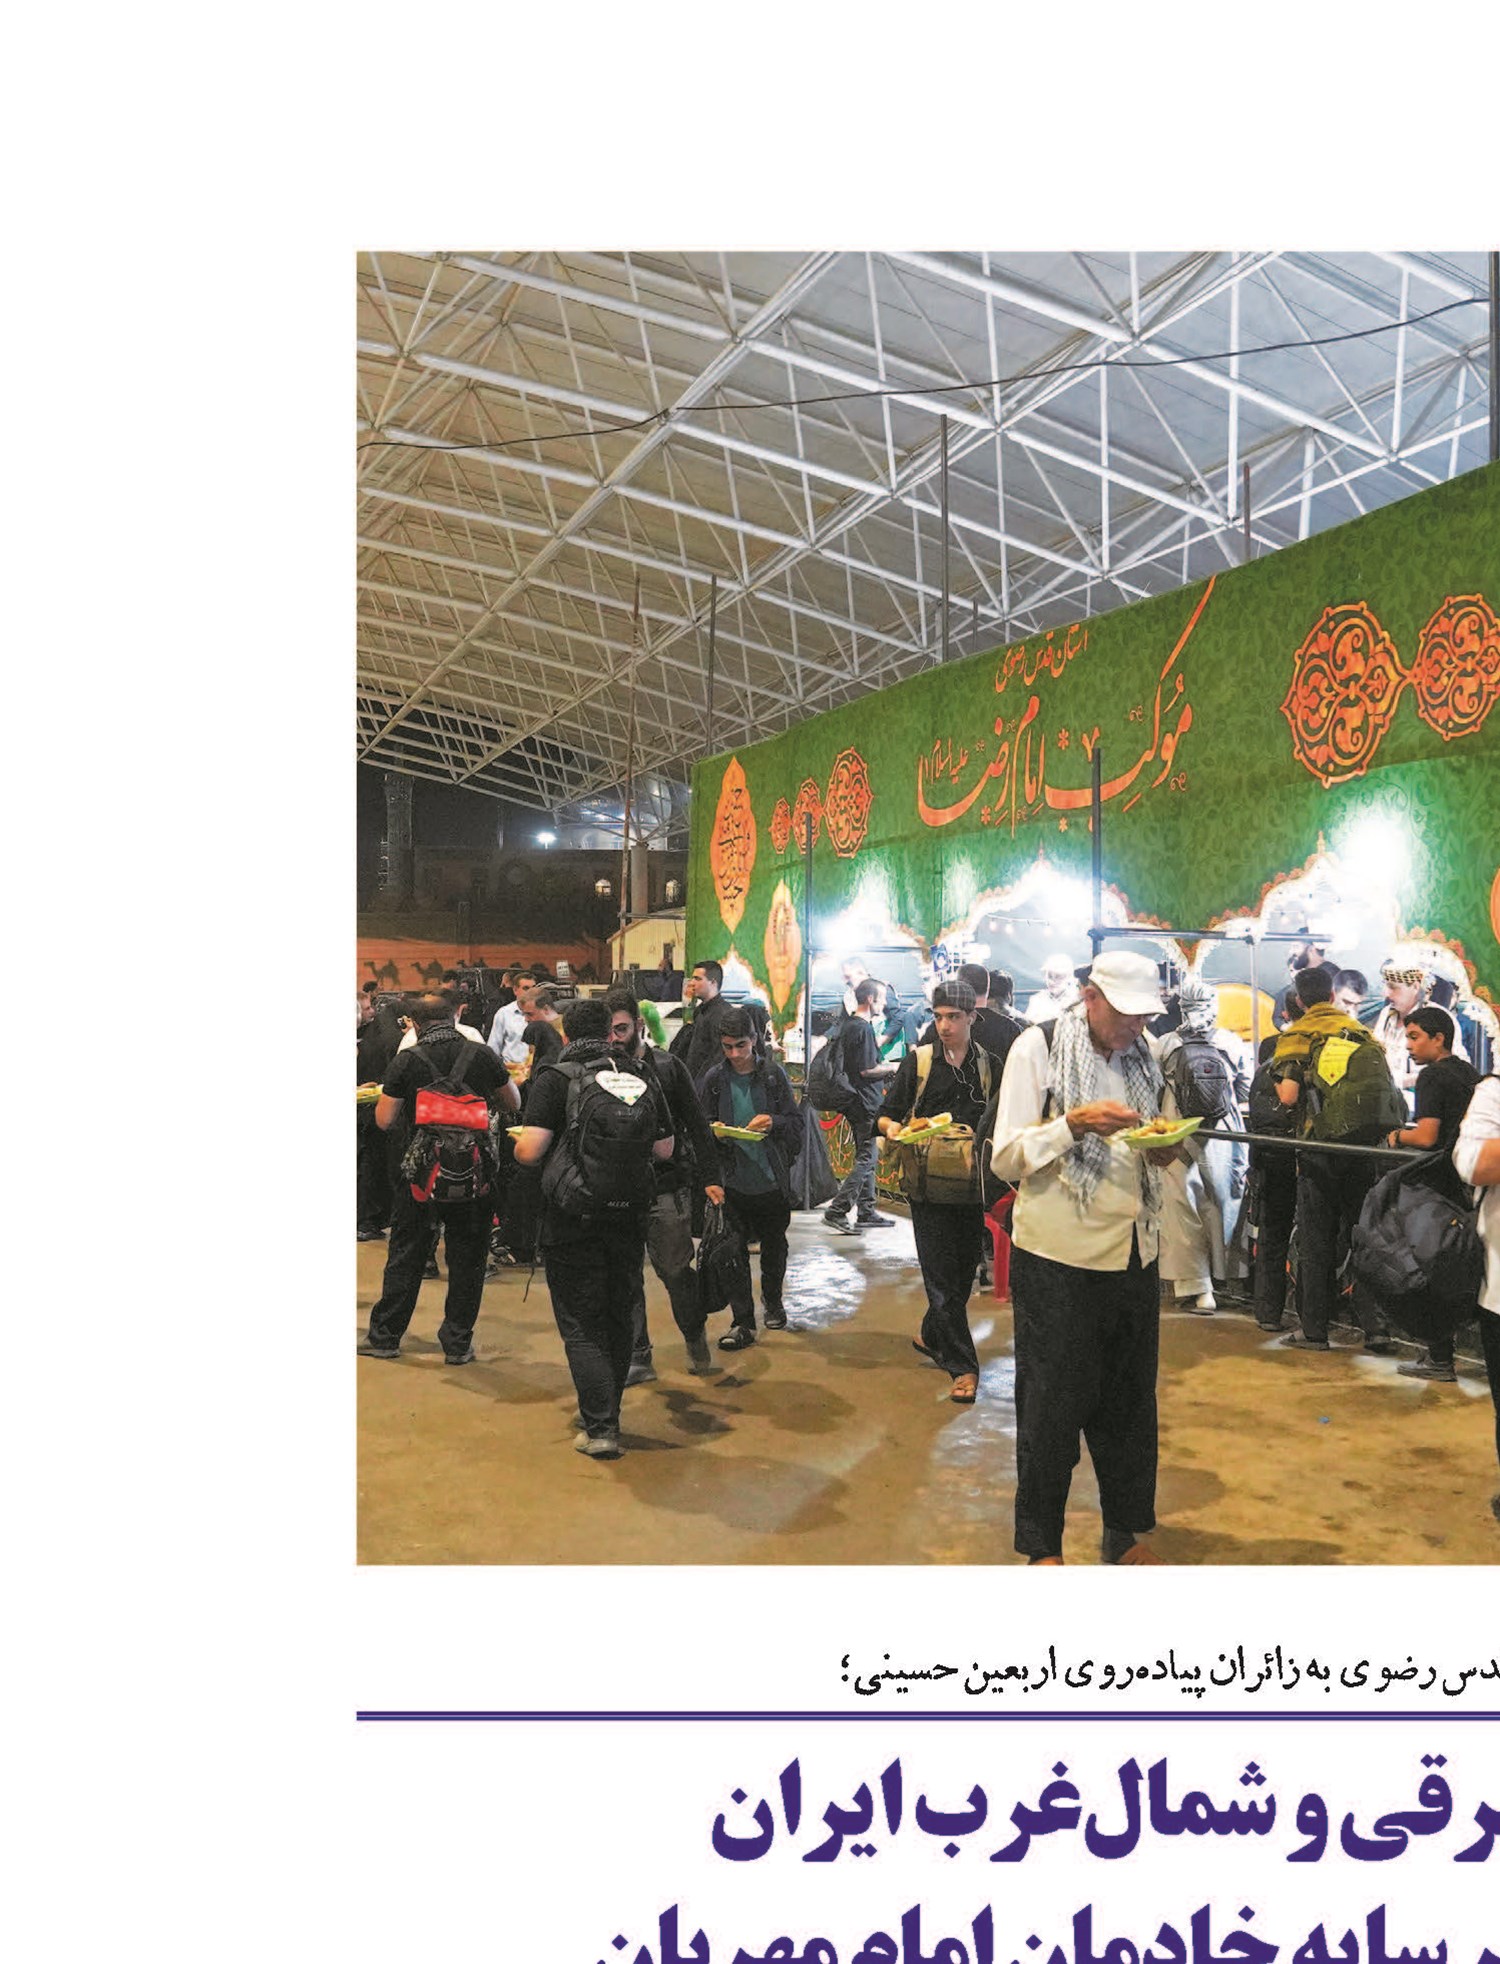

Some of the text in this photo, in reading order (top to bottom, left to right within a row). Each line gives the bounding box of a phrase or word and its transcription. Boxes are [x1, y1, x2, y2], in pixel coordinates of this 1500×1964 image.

[964, 1645, 1056, 1694] اربعین
[1210, 1645, 1300, 1692] زائران
[1307, 1659, 1331, 1692] به
[1341, 1656, 1436, 1692] رضوی
[1443, 1659, 1500, 1696] دس
[712, 1758, 902, 1862] ایران
[1287, 1794, 1328, 1862] و
[1341, 1754, 1500, 1862] رقی
